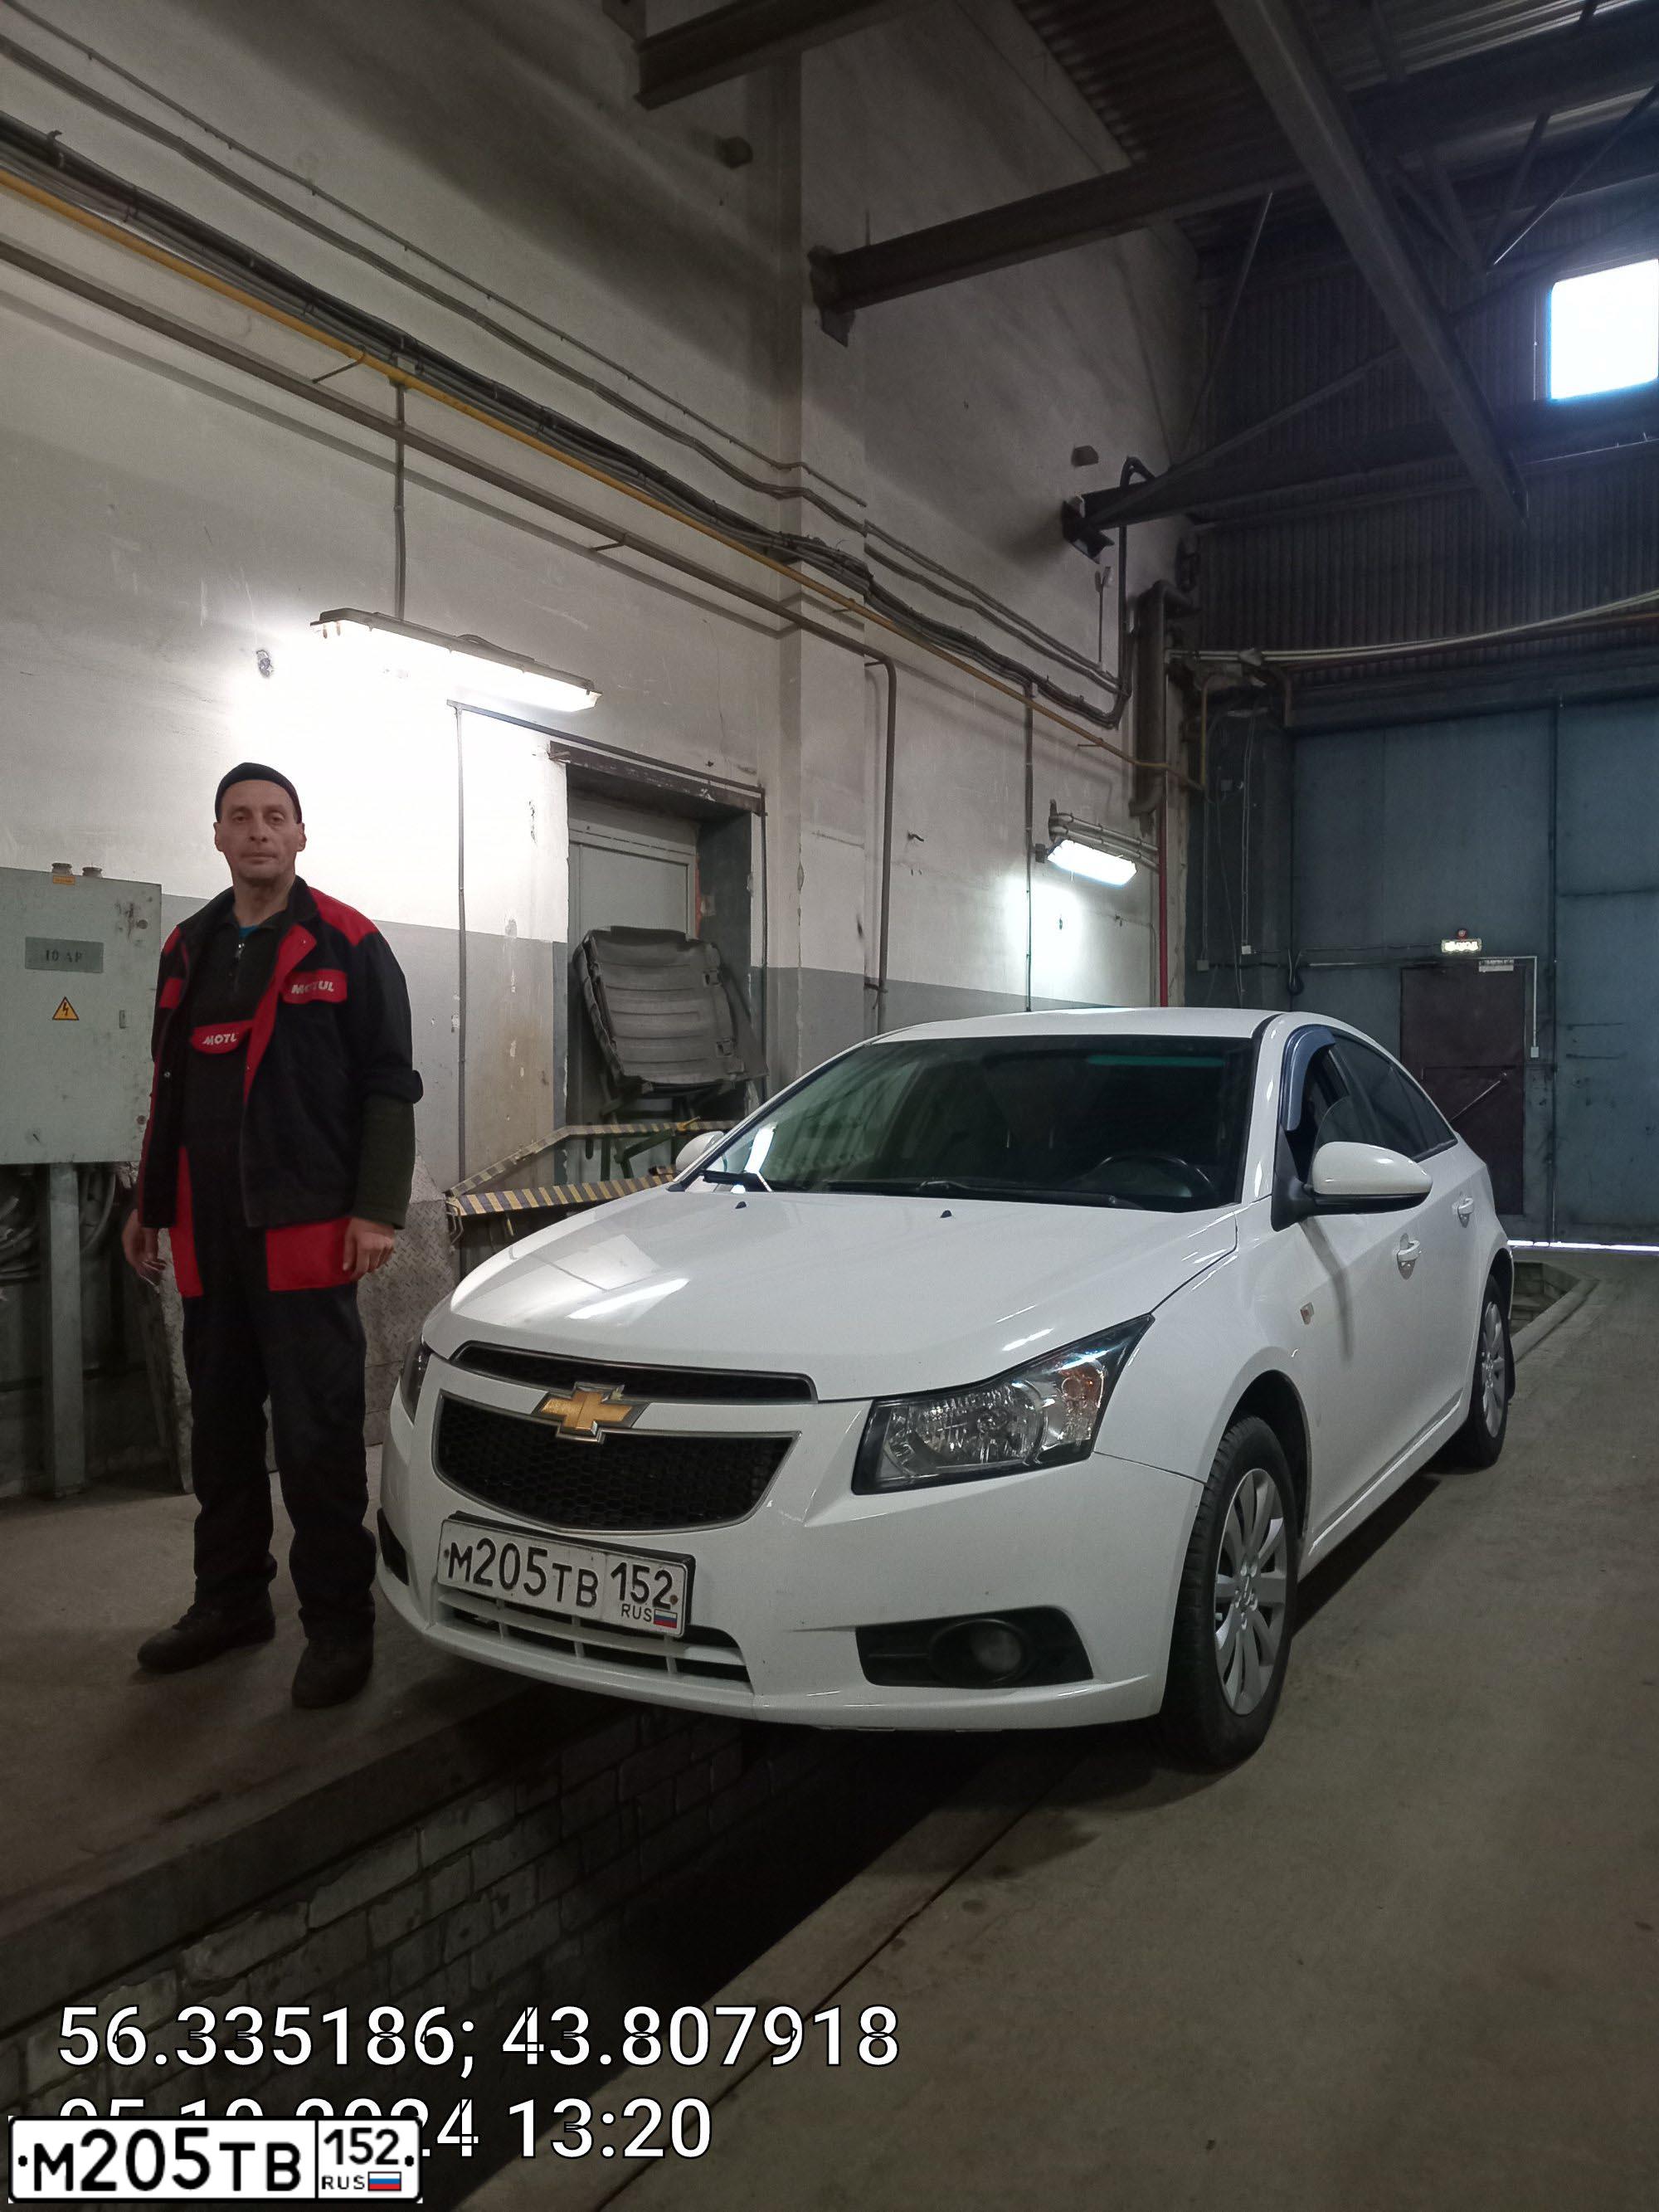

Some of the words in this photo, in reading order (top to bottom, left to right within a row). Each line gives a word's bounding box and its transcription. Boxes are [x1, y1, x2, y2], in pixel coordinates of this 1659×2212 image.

[448, 1537, 599, 1608] М205ТВ
[611, 1562, 674, 1610] 152
[621, 1602, 652, 1623] RUS
